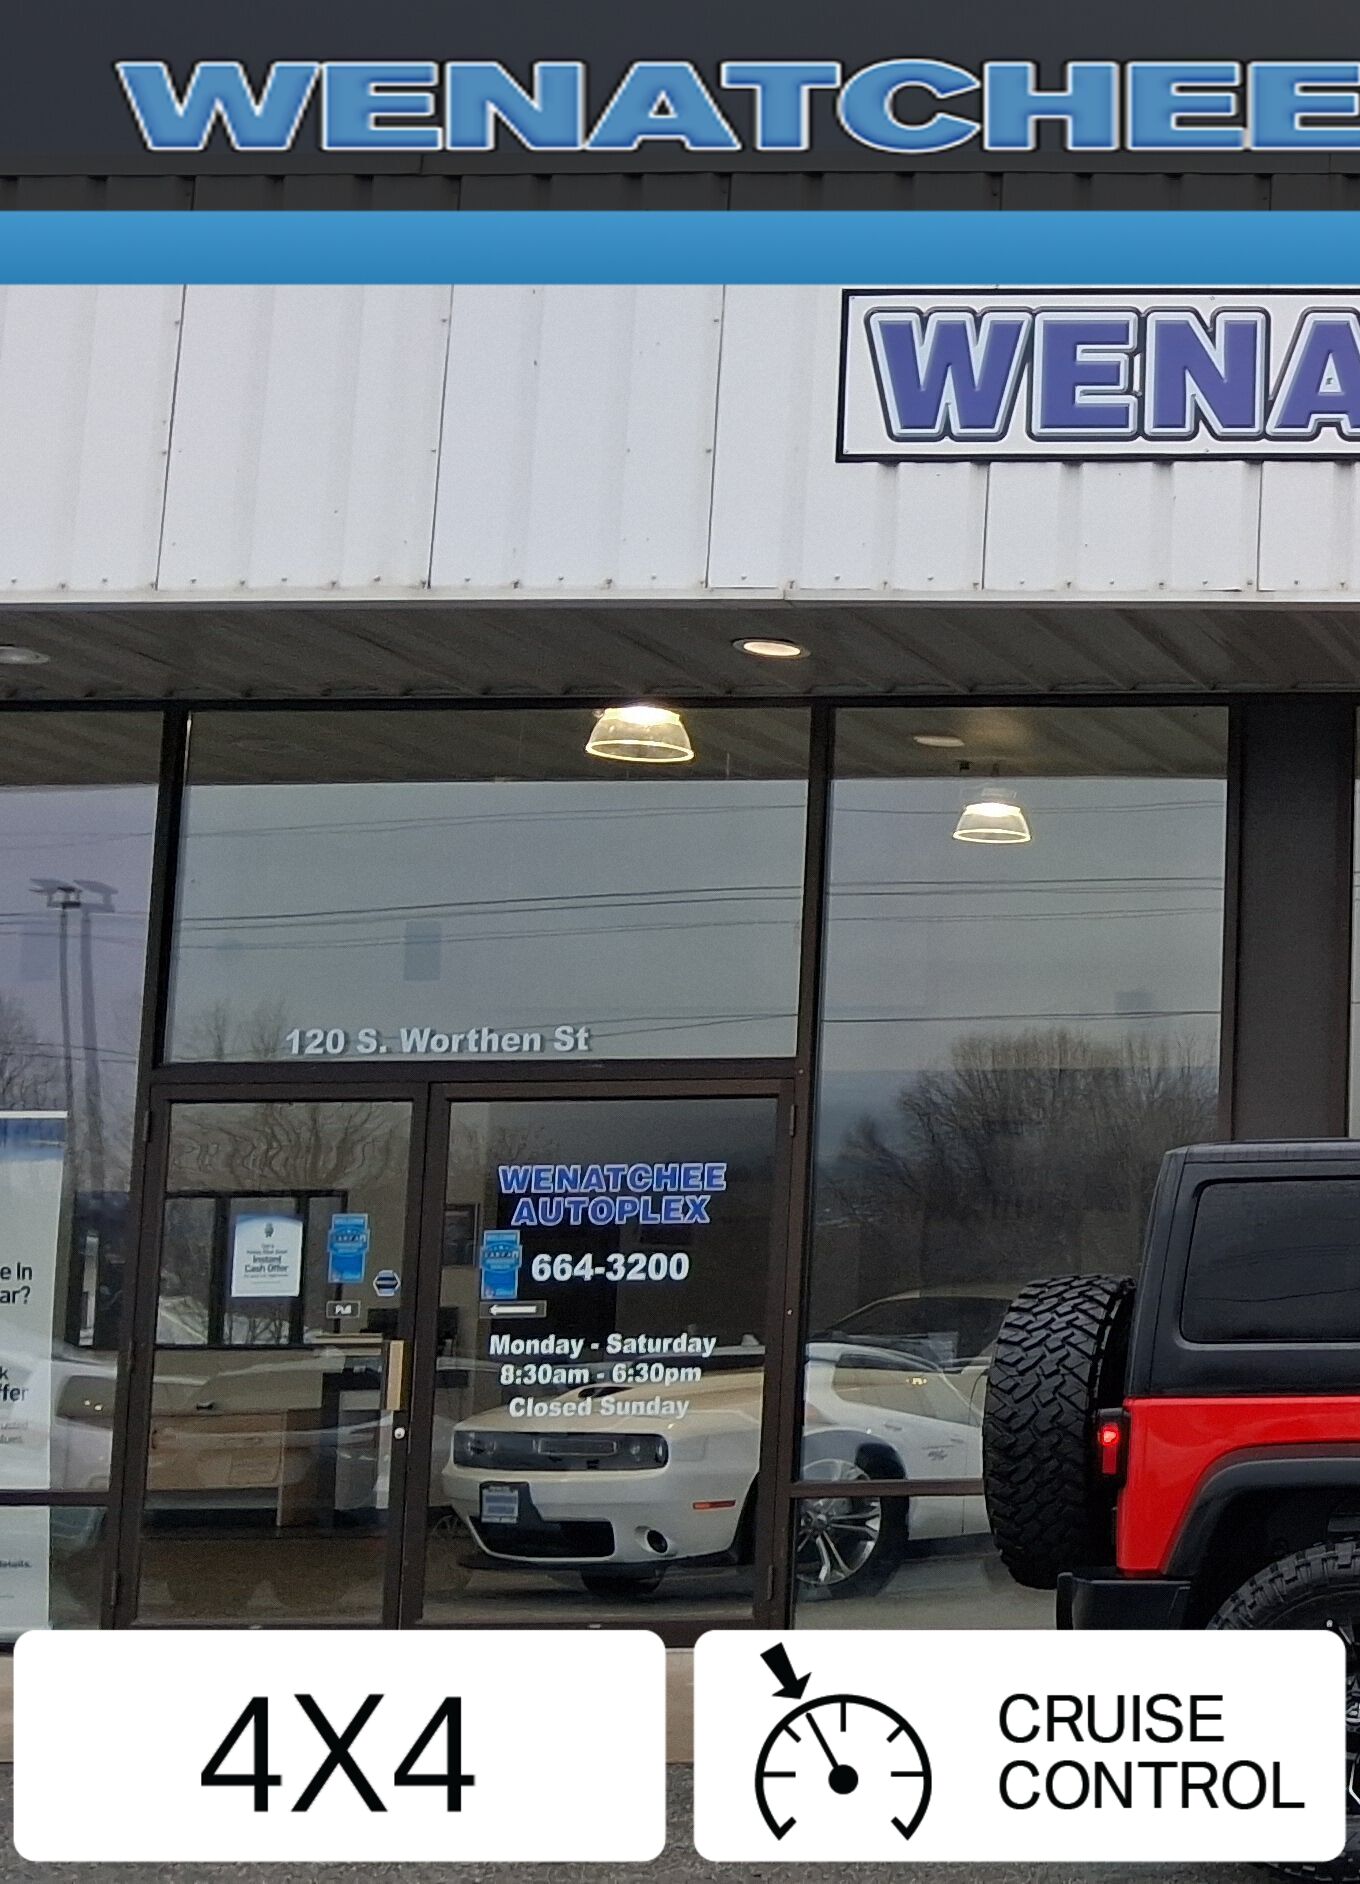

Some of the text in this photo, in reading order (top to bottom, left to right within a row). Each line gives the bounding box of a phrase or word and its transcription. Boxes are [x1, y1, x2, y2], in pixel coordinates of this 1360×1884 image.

[285, 1025, 589, 1055] 120 S. Worthen St
[498, 1162, 727, 1194] WENATCHEE
[511, 1194, 711, 1226] AUTOPLEX
[17, 1262, 32, 1280] In
[531, 1252, 690, 1282] 664-3200
[489, 1333, 585, 1361] Monday
[605, 1332, 717, 1359] Saturday
[500, 1363, 590, 1386] 8:30am
[612, 1361, 703, 1387] 6:30pm
[508, 1396, 690, 1419] Closed Sunday
